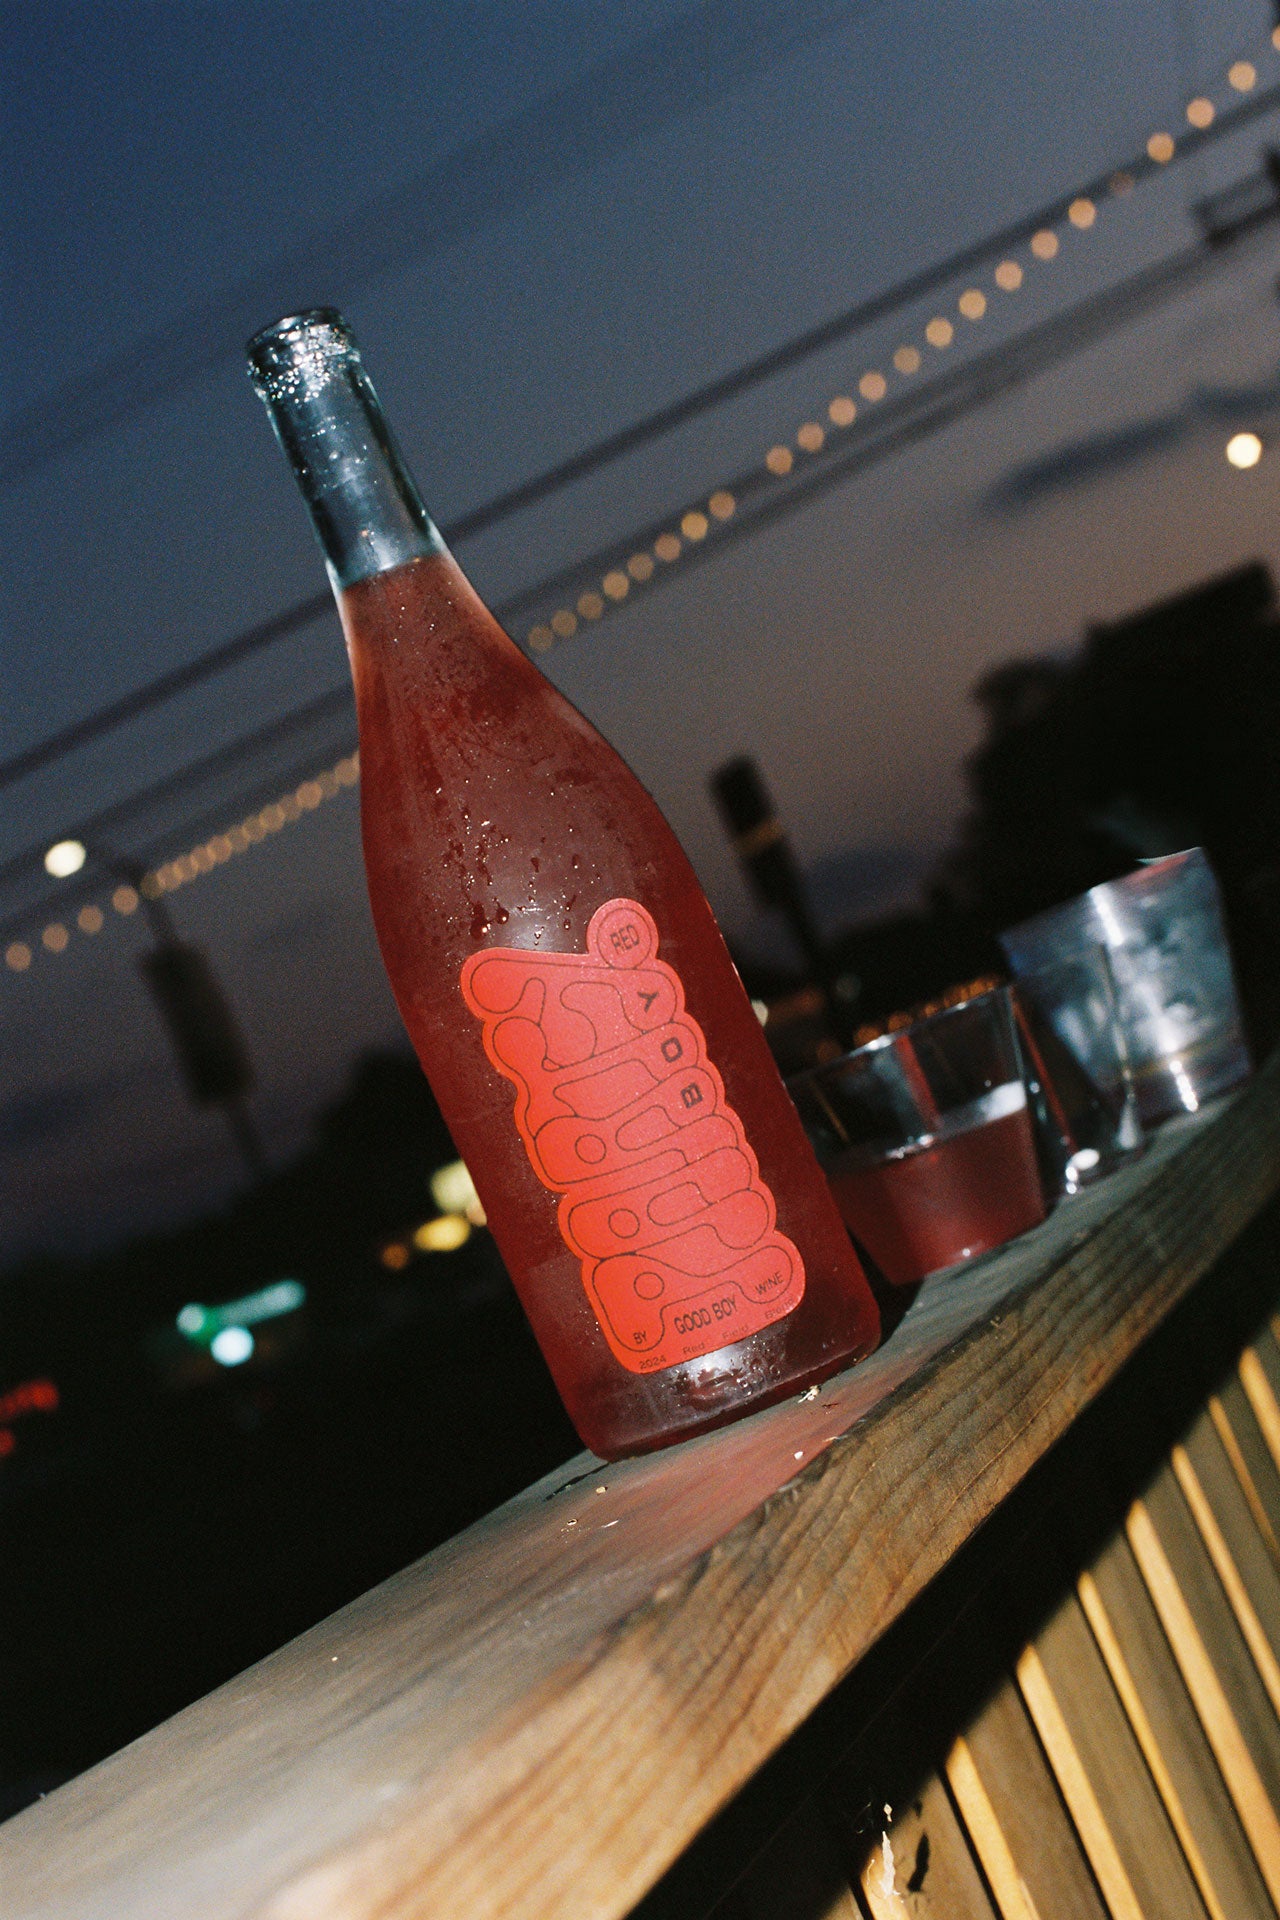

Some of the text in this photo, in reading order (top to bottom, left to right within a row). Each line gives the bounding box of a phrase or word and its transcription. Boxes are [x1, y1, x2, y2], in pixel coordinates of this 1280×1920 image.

[610, 924, 640, 954] RED
[633, 1271, 784, 1345] BY GOOD BOY WINE
[639, 1355, 667, 1370] 2024
[683, 1342, 706, 1356] Red
